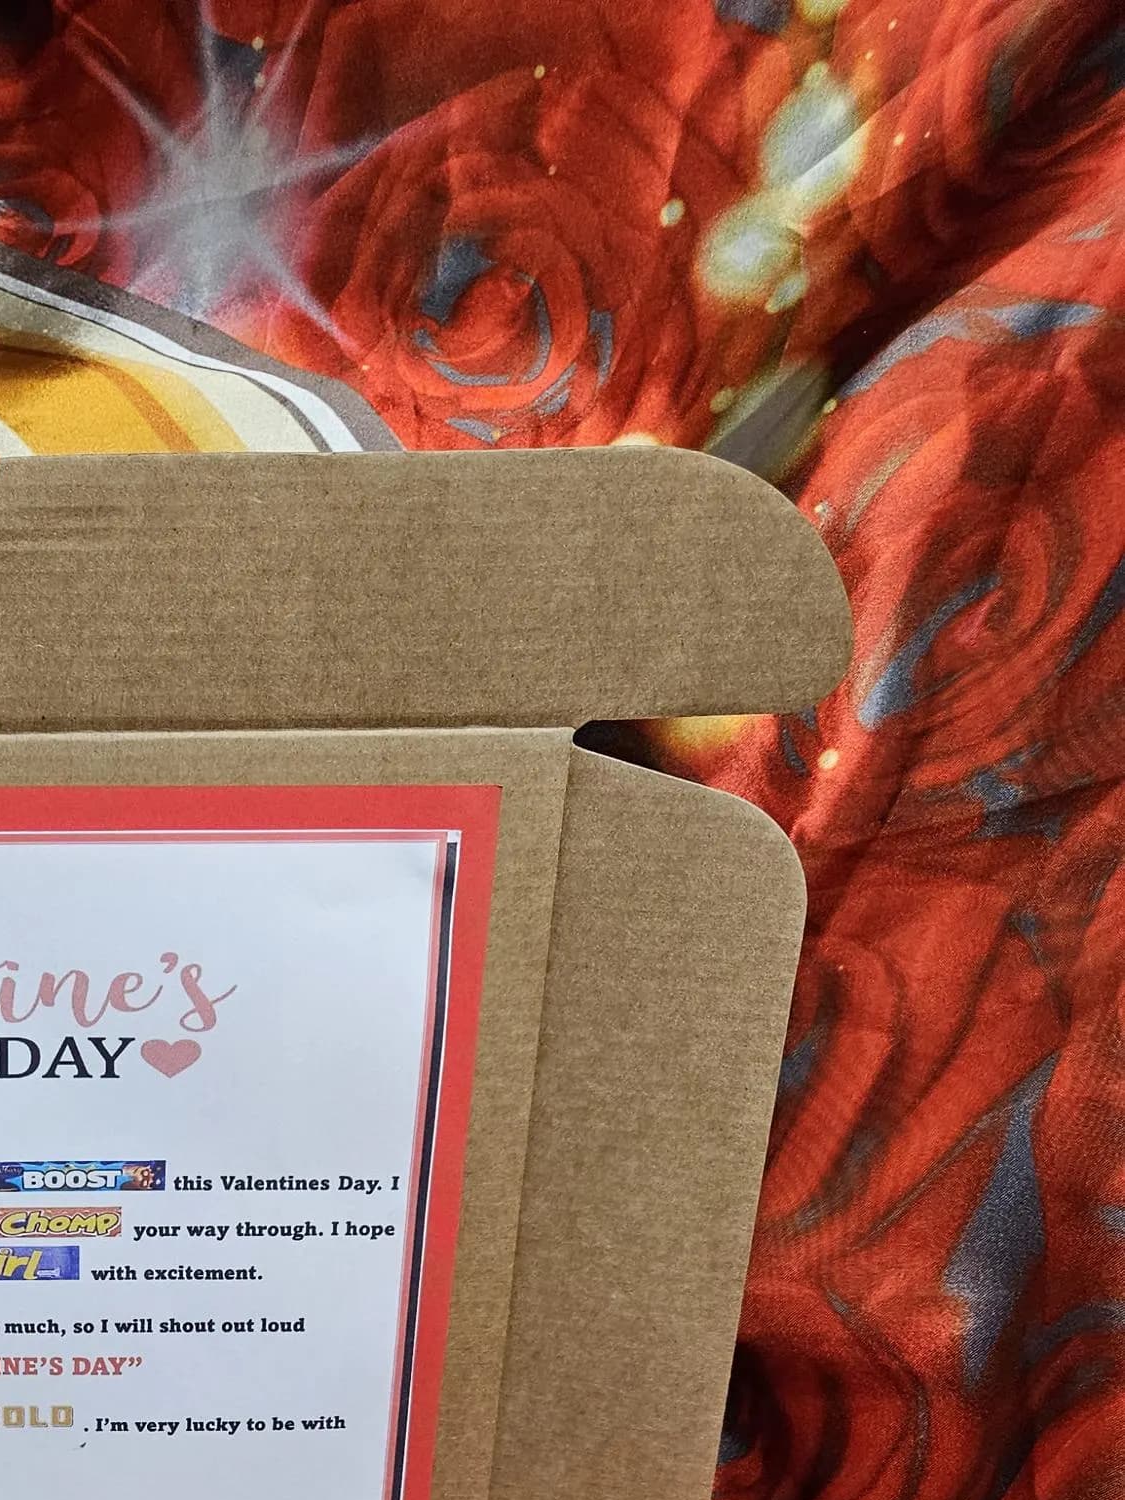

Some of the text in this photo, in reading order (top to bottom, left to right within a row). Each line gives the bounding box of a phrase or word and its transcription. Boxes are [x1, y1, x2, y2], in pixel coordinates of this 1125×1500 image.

[23, 1170, 122, 1189] BOOST
[173, 1175, 213, 1192] this
[220, 1175, 330, 1191] Valentines
[337, 1175, 382, 1195] Day.
[390, 1175, 400, 1191] I
[133, 1225, 181, 1242] your
[186, 1225, 230, 1241] way
[235, 1220, 324, 1241] through.
[330, 1221, 340, 1236] I
[344, 1220, 395, 1240] hope
[90, 1265, 138, 1281] with
[143, 1265, 263, 1281] excitement.
[4, 1318, 66, 1338] much,
[73, 1322, 95, 1334] so
[100, 1318, 109, 1334] I
[114, 1318, 154, 1334] will
[159, 1317, 216, 1334] shout
[221, 1318, 255, 1333] out
[260, 1317, 306, 1333] loud
[95, 1417, 129, 1432] I’m
[134, 1421, 180, 1436] very
[185, 1417, 241, 1436] lucky
[246, 1417, 266, 1432] to
[271, 1416, 295, 1431] be
[300, 1415, 346, 1430] with
